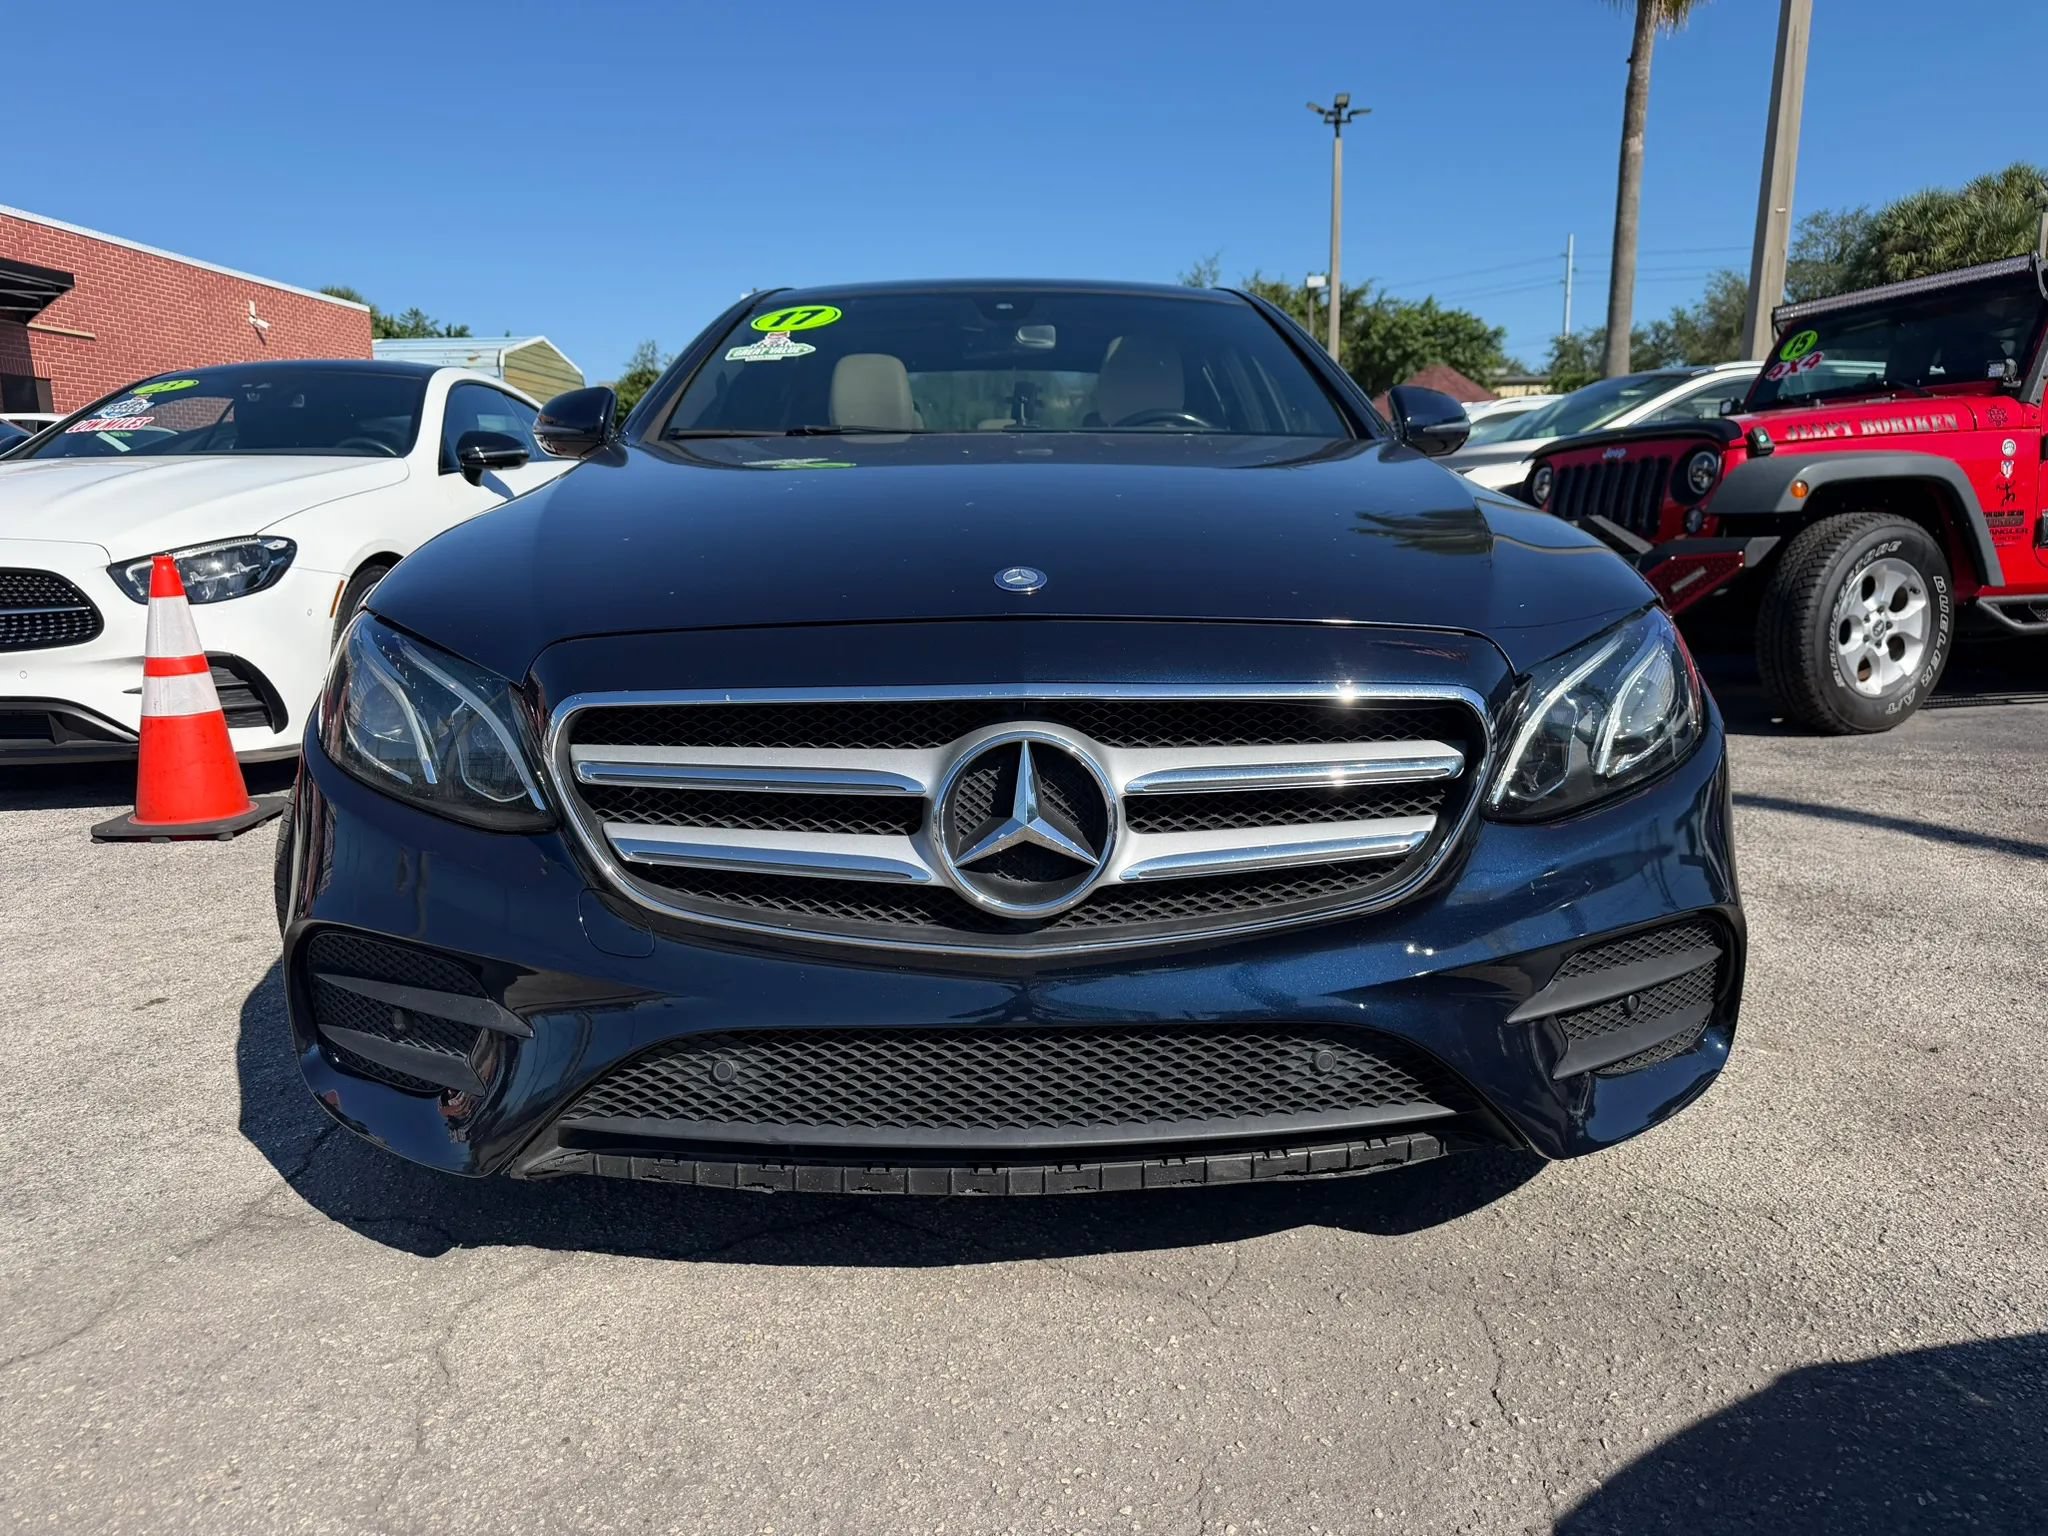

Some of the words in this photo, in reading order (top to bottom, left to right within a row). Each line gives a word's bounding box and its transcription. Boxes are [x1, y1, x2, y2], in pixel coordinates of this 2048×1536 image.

[769, 308, 826, 328] 17
[1786, 332, 1813, 357] 15
[66, 419, 102, 433] LOW
[101, 416, 154, 431] MILES
[1860, 413, 1958, 436] BORIKEN
[1602, 446, 1627, 460] Jeep
[1920, 575, 1949, 689] DUELER
